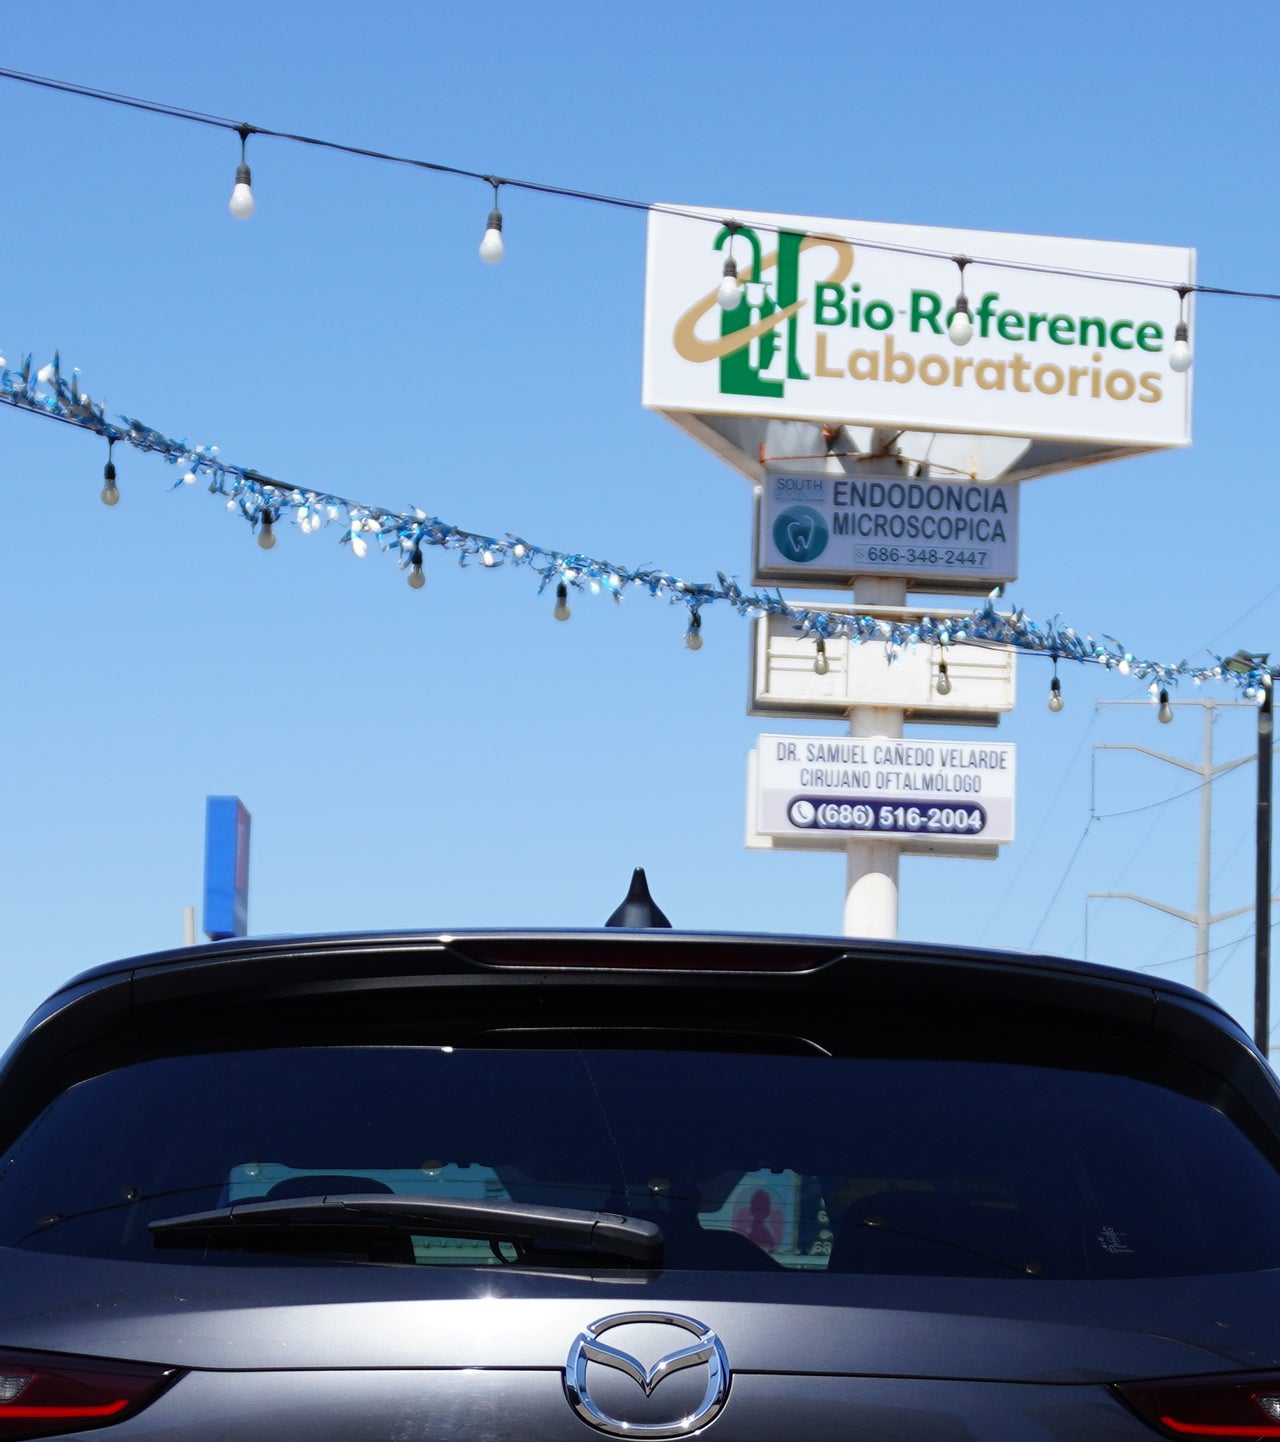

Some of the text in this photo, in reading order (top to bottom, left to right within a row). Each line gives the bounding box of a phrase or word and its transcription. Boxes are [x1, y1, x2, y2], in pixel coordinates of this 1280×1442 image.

[814, 331, 1164, 404] Laboratorios
[776, 478, 824, 491] SOUTH
[833, 480, 1008, 514] ENDODONCIA
[832, 513, 1007, 542] MICROSCOPICA
[867, 546, 988, 566] 686-348-2447
[776, 741, 1008, 769] DR. SAMUEL CAÑEDO VELARDE
[800, 768, 982, 793] CIRUJANO OFTALMÓLOGO
[817, 803, 982, 831] (686) 516-2004
